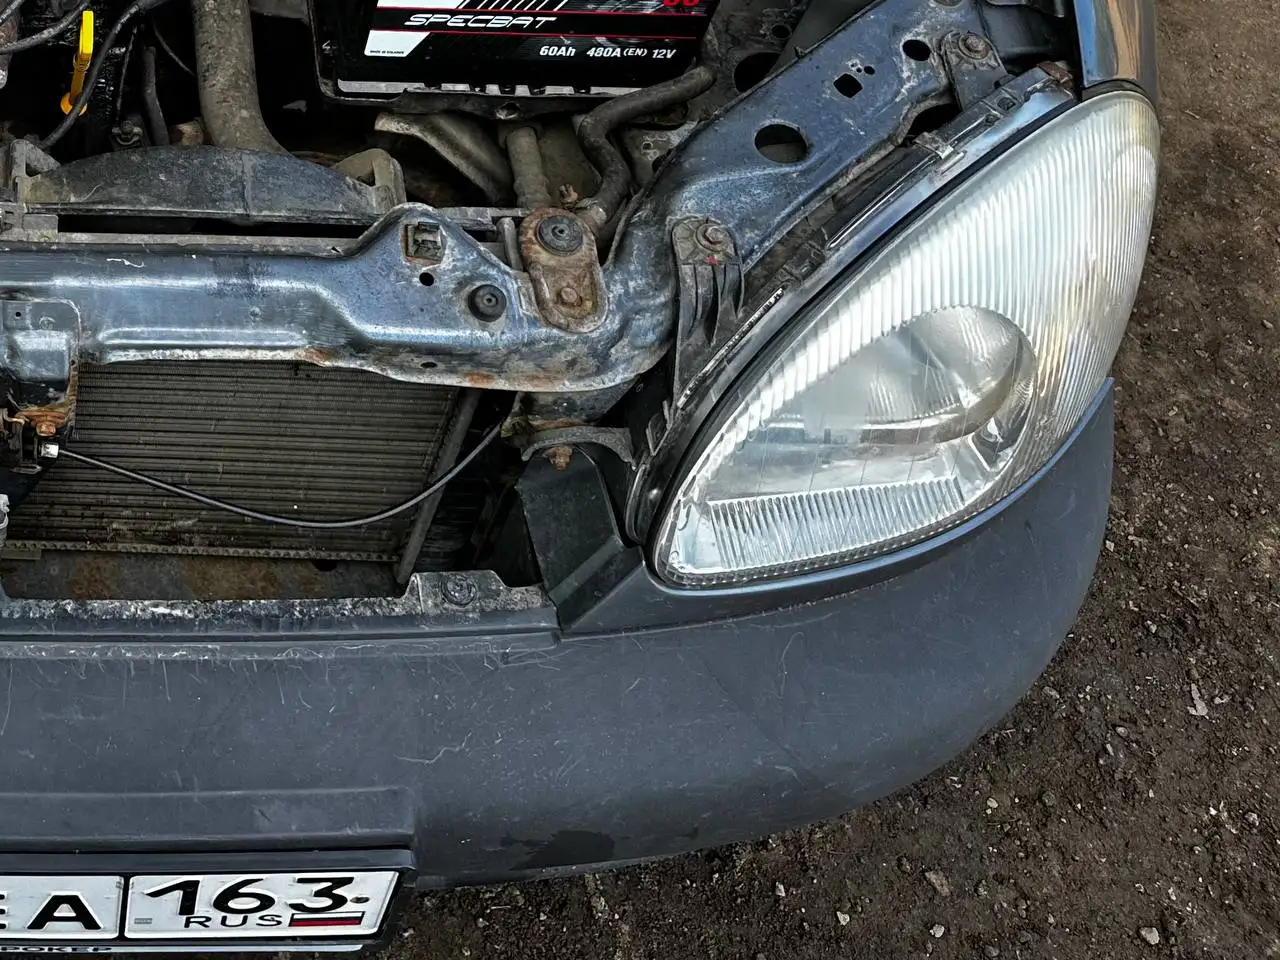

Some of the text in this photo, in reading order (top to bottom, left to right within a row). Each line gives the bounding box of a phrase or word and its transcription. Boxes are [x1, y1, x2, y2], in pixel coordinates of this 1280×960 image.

[404, 13, 557, 29] SPECBAT
[539, 45, 677, 59] 60Ah 480A (EN) 12V
[144, 876, 356, 916] 163
[183, 914, 283, 928] RUS
